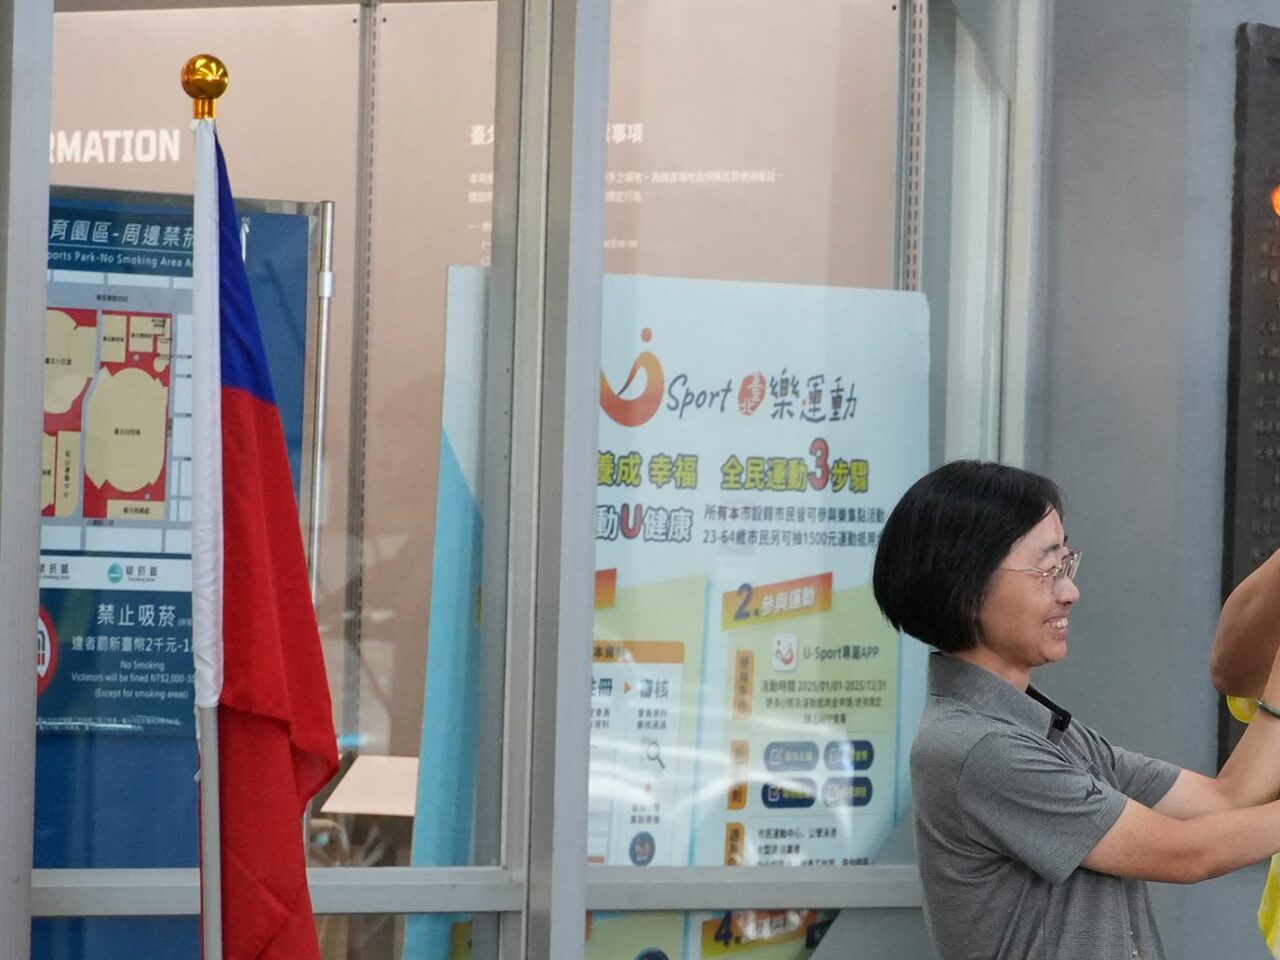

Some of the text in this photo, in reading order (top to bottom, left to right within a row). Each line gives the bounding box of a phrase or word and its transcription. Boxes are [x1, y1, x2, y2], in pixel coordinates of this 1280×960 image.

[606, 123, 643, 144] 事項
[117, 255, 158, 268] Smoking
[667, 373, 733, 418] Sport
[648, 454, 699, 490] 幸福
[97, 603, 176, 628] 禁止吸菸
